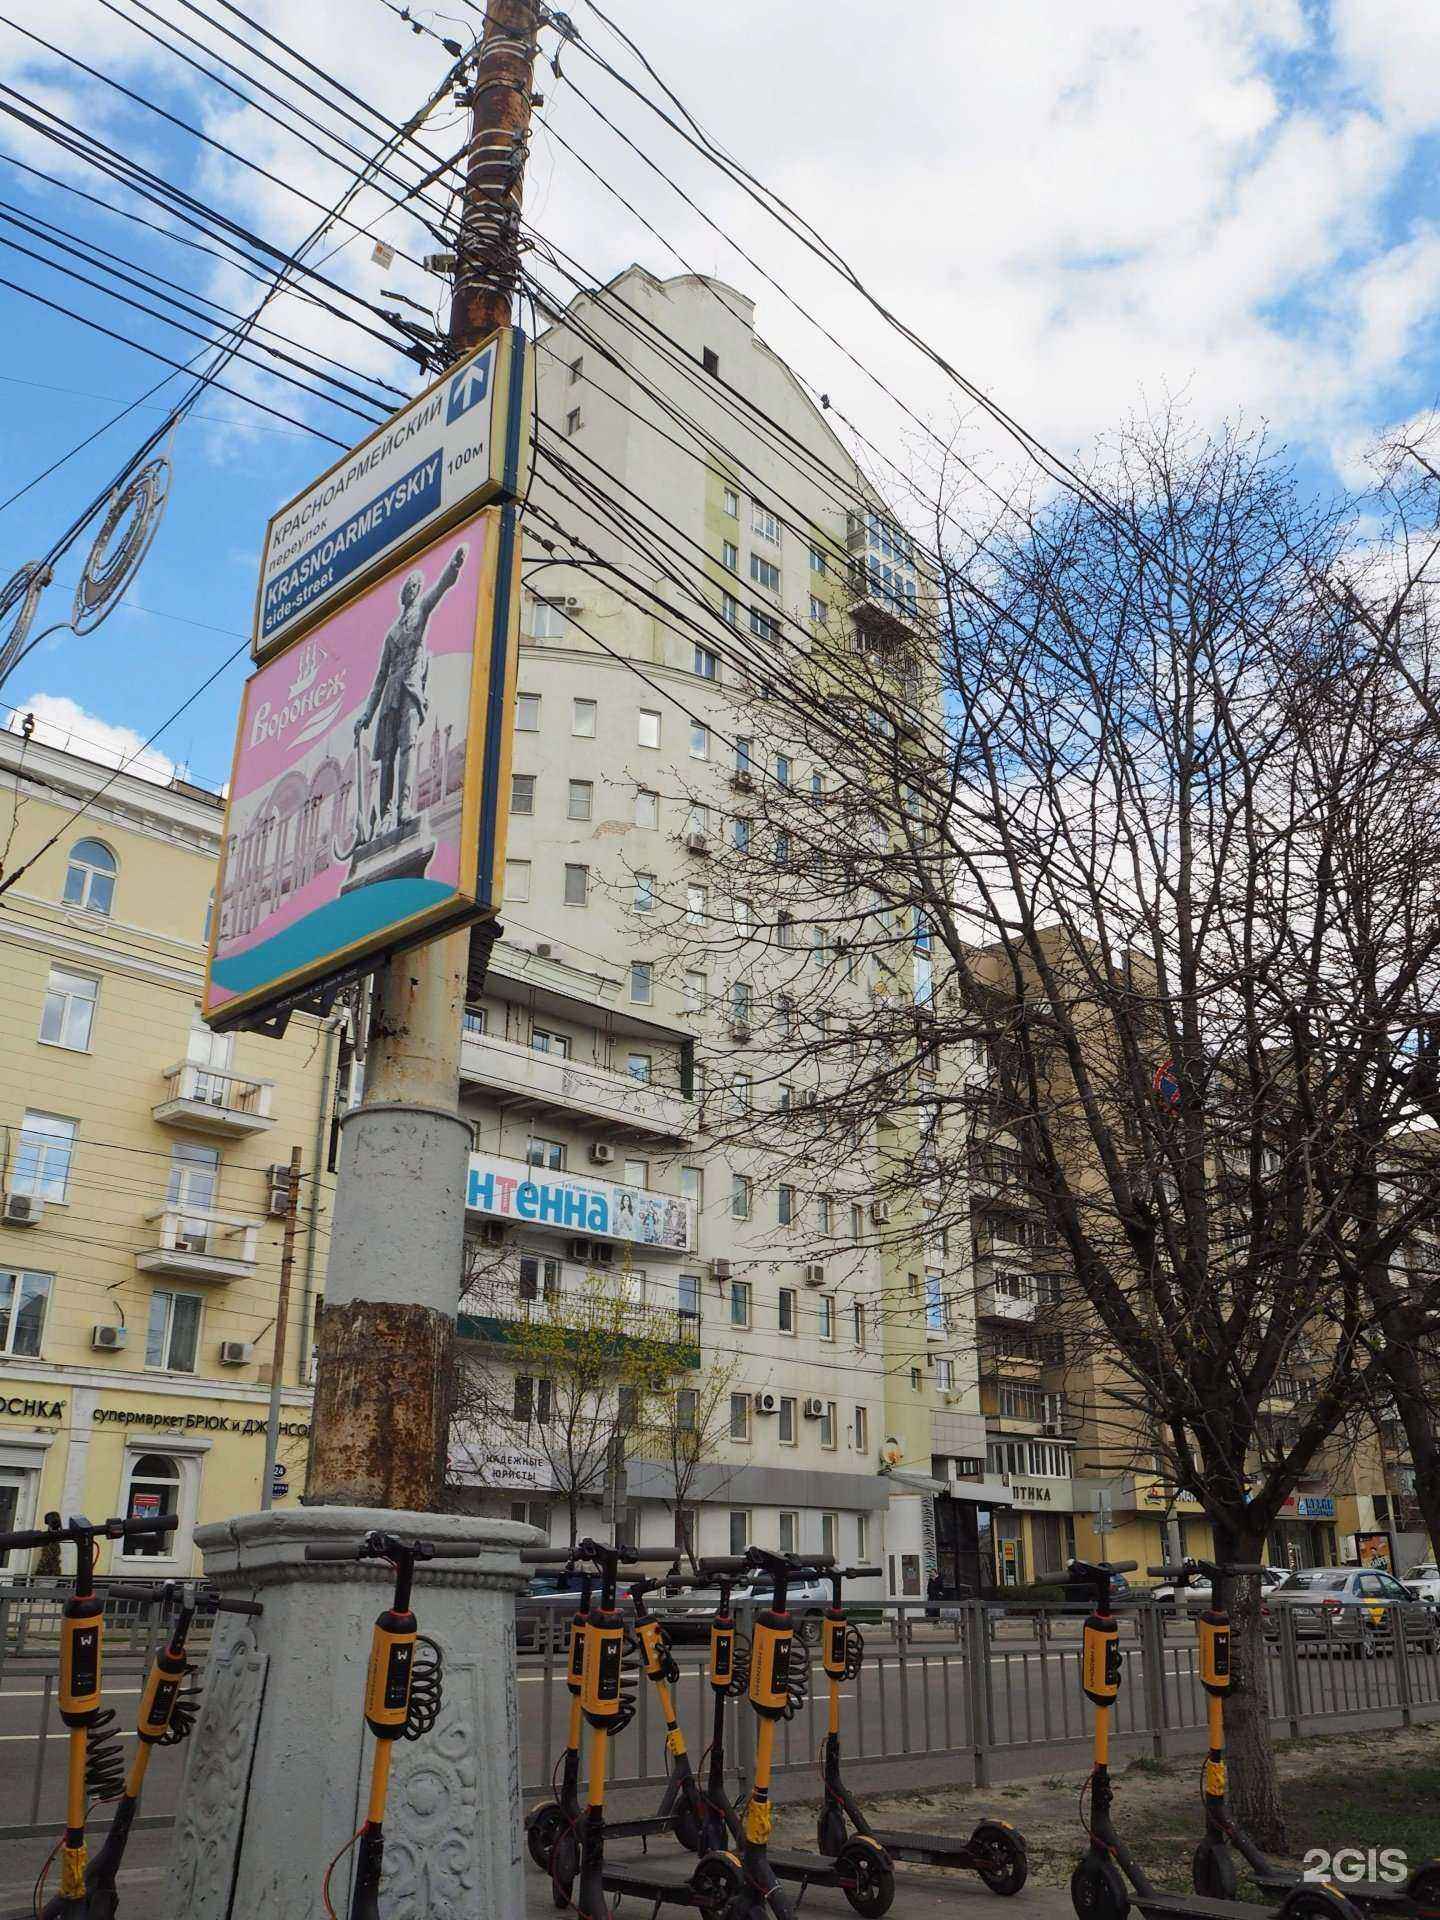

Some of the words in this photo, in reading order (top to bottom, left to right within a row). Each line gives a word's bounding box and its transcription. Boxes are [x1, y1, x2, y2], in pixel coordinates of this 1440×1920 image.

[272, 394, 443, 548] КРАСНОАРМЕЙСКИЙ
[266, 456, 440, 609] KRASNOARMEYSKIY
[268, 517, 328, 574] переулок
[265, 566, 334, 631] side-street
[247, 668, 346, 751] Воронеж
[468, 1168, 610, 1234] нтенна
[93, 1408, 184, 1429] супермаркет
[185, 1414, 229, 1431] БРЮК
[242, 1419, 313, 1438] ДЖНСО
[492, 1468, 537, 1482] ЮРИСТЫ
[1012, 1485, 1052, 1502] ПТИКА
